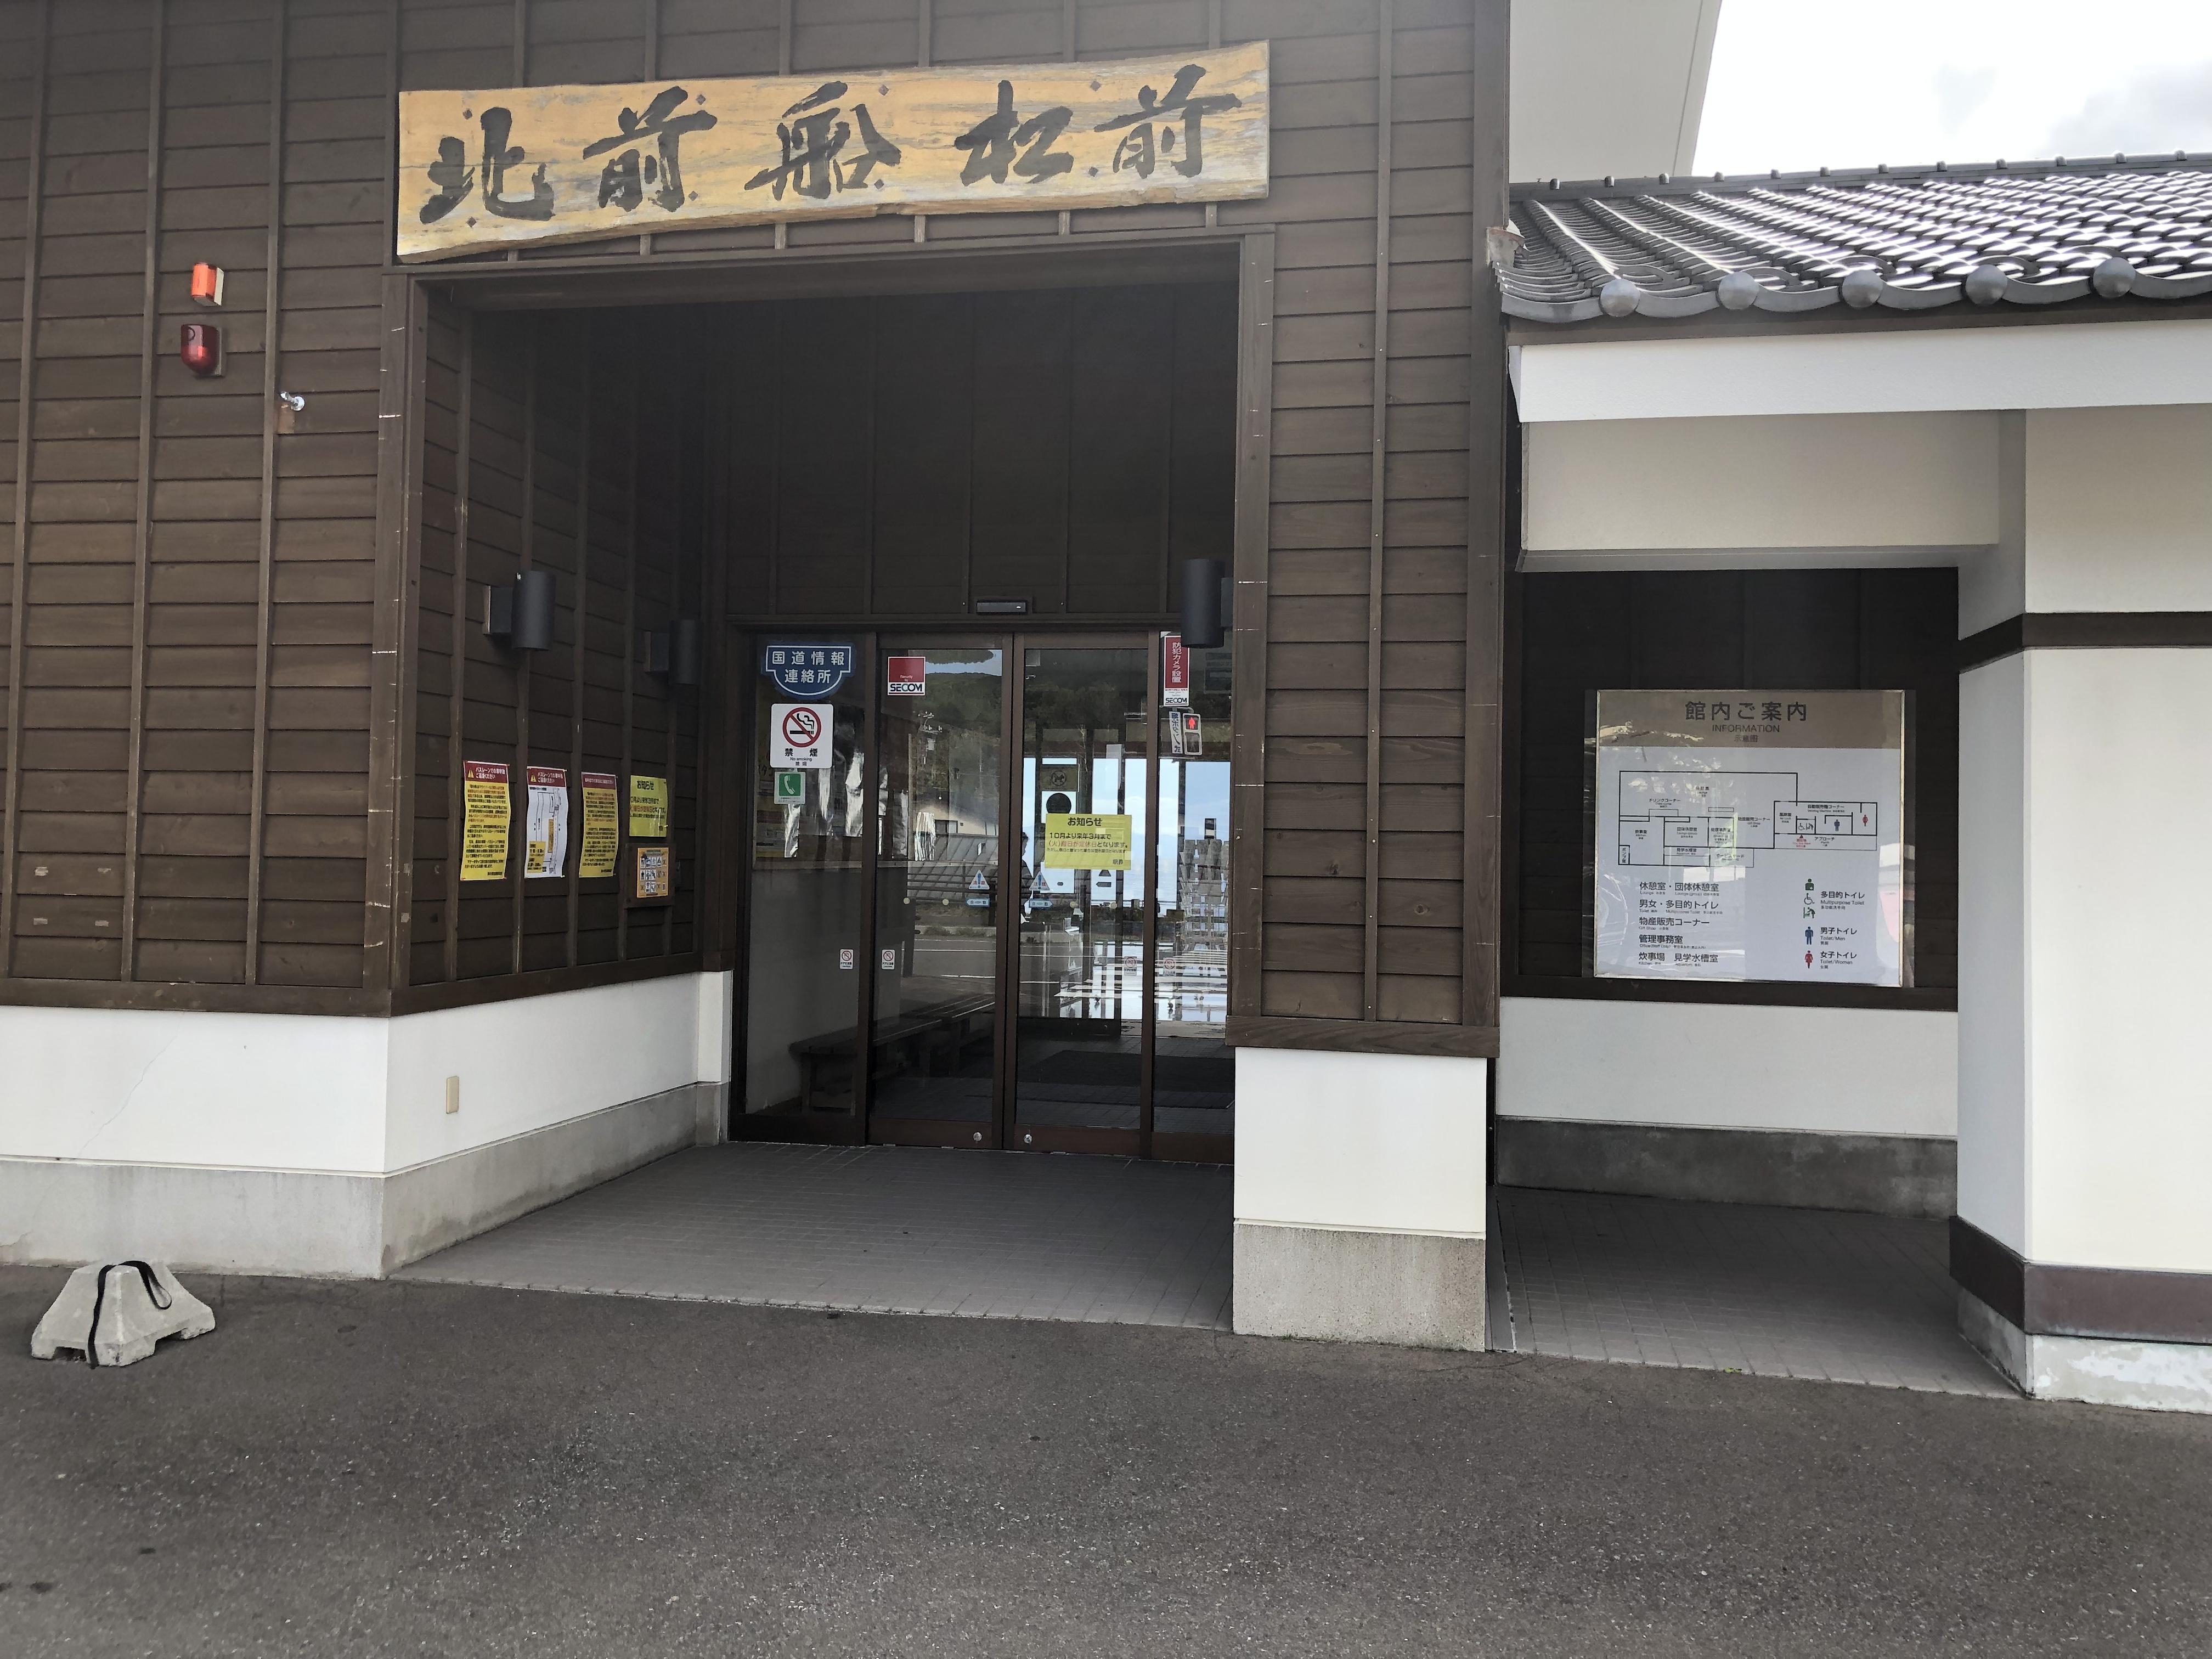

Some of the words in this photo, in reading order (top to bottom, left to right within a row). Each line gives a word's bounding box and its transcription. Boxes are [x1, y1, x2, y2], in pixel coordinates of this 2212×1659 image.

[419, 63, 1243, 224] 北前船松前
[772, 651, 844, 665] 国道情報
[1172, 642, 1182, 683] 防犯カメラ設置
[785, 669, 831, 684] 連絡所
[890, 683, 922, 692] SECOM
[1685, 701, 1807, 721] 館内ご案内
[1712, 724, 1780, 733] INFORMATION
[785, 748, 818, 757] 禁煙
[1067, 817, 1103, 827] お知らせ
[1639, 881, 1719, 892] 休憩室・団体休憩室
[1639, 899, 1719, 909] 男女・多目的トイレ
[1639, 917, 1710, 927] 物産販売コーナー
[1820, 927, 1858, 935] 男子トイレ
[1639, 934, 1683, 944] 管理事務室
[1639, 952, 1665, 961] 炊事場
[1674, 953, 1718, 963] 見学水槽室
[1820, 951, 1857, 959] 女子トイレ
